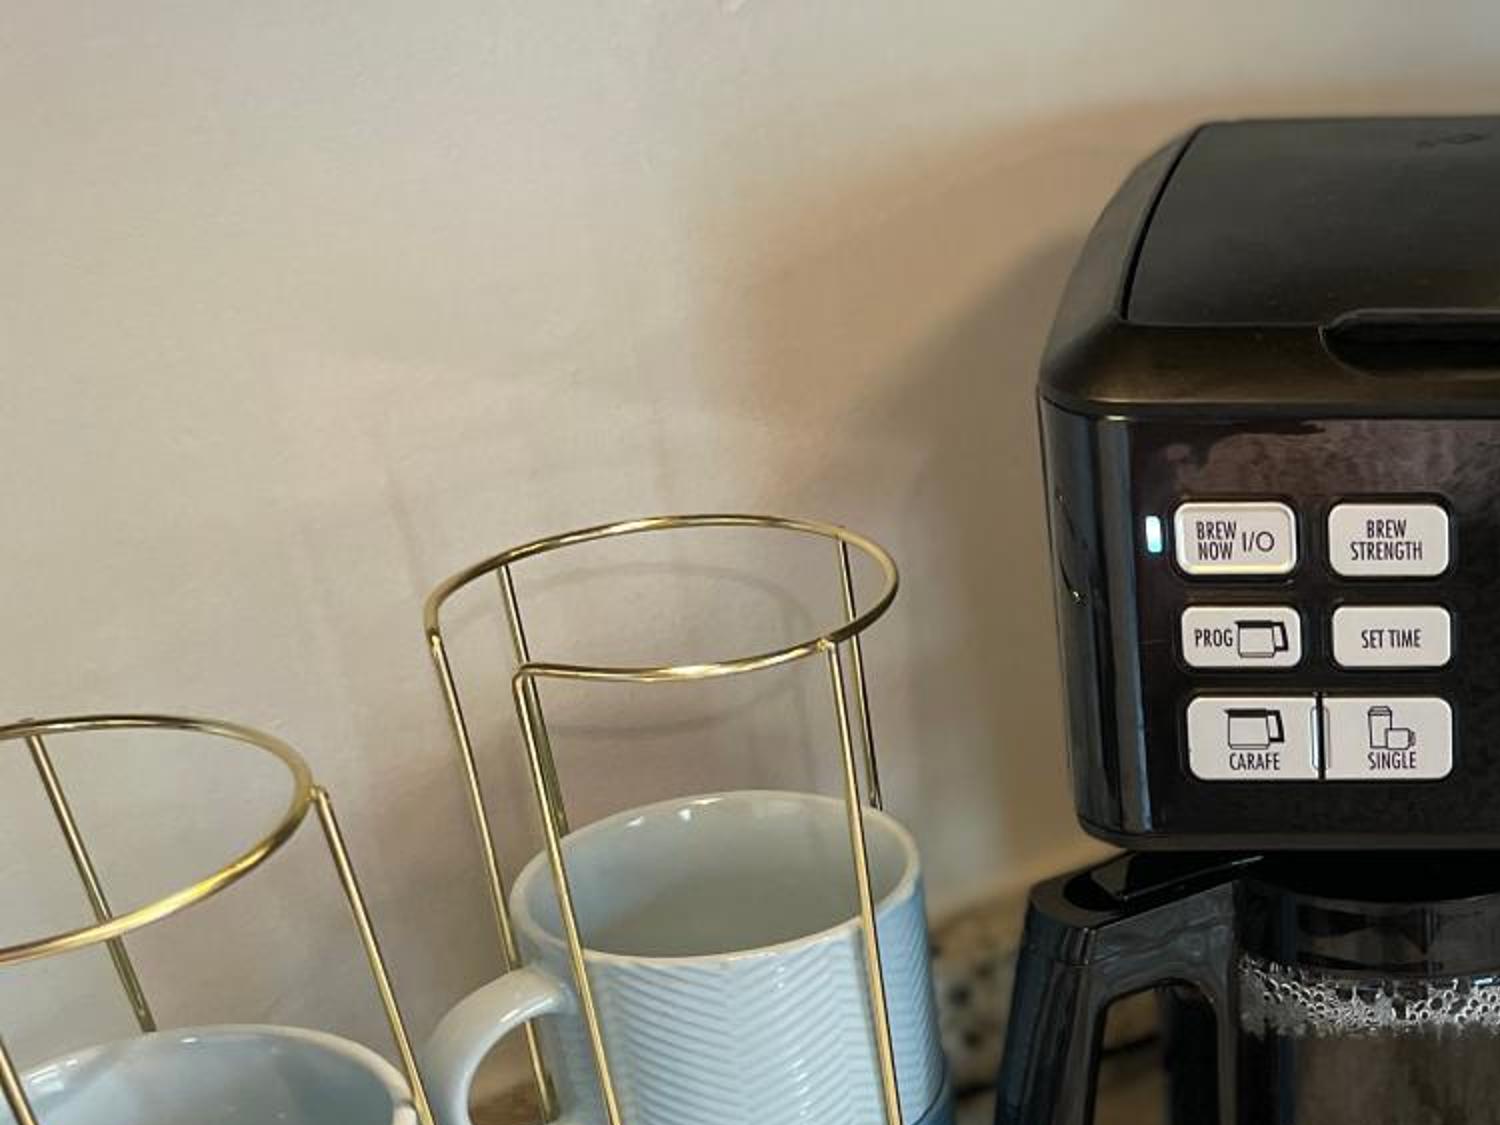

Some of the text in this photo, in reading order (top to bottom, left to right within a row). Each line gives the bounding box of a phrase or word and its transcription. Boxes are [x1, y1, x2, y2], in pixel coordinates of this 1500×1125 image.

[1195, 520, 1237, 540] BREW
[1366, 519, 1407, 539] BREW
[1197, 541, 1233, 561] NOW
[1350, 541, 1423, 561] STRENGTH
[1194, 629, 1233, 648] PROG
[1361, 628, 1422, 649] SET TIME
[1229, 752, 1281, 771] CARAFE
[1367, 751, 1417, 770] SINGLE
